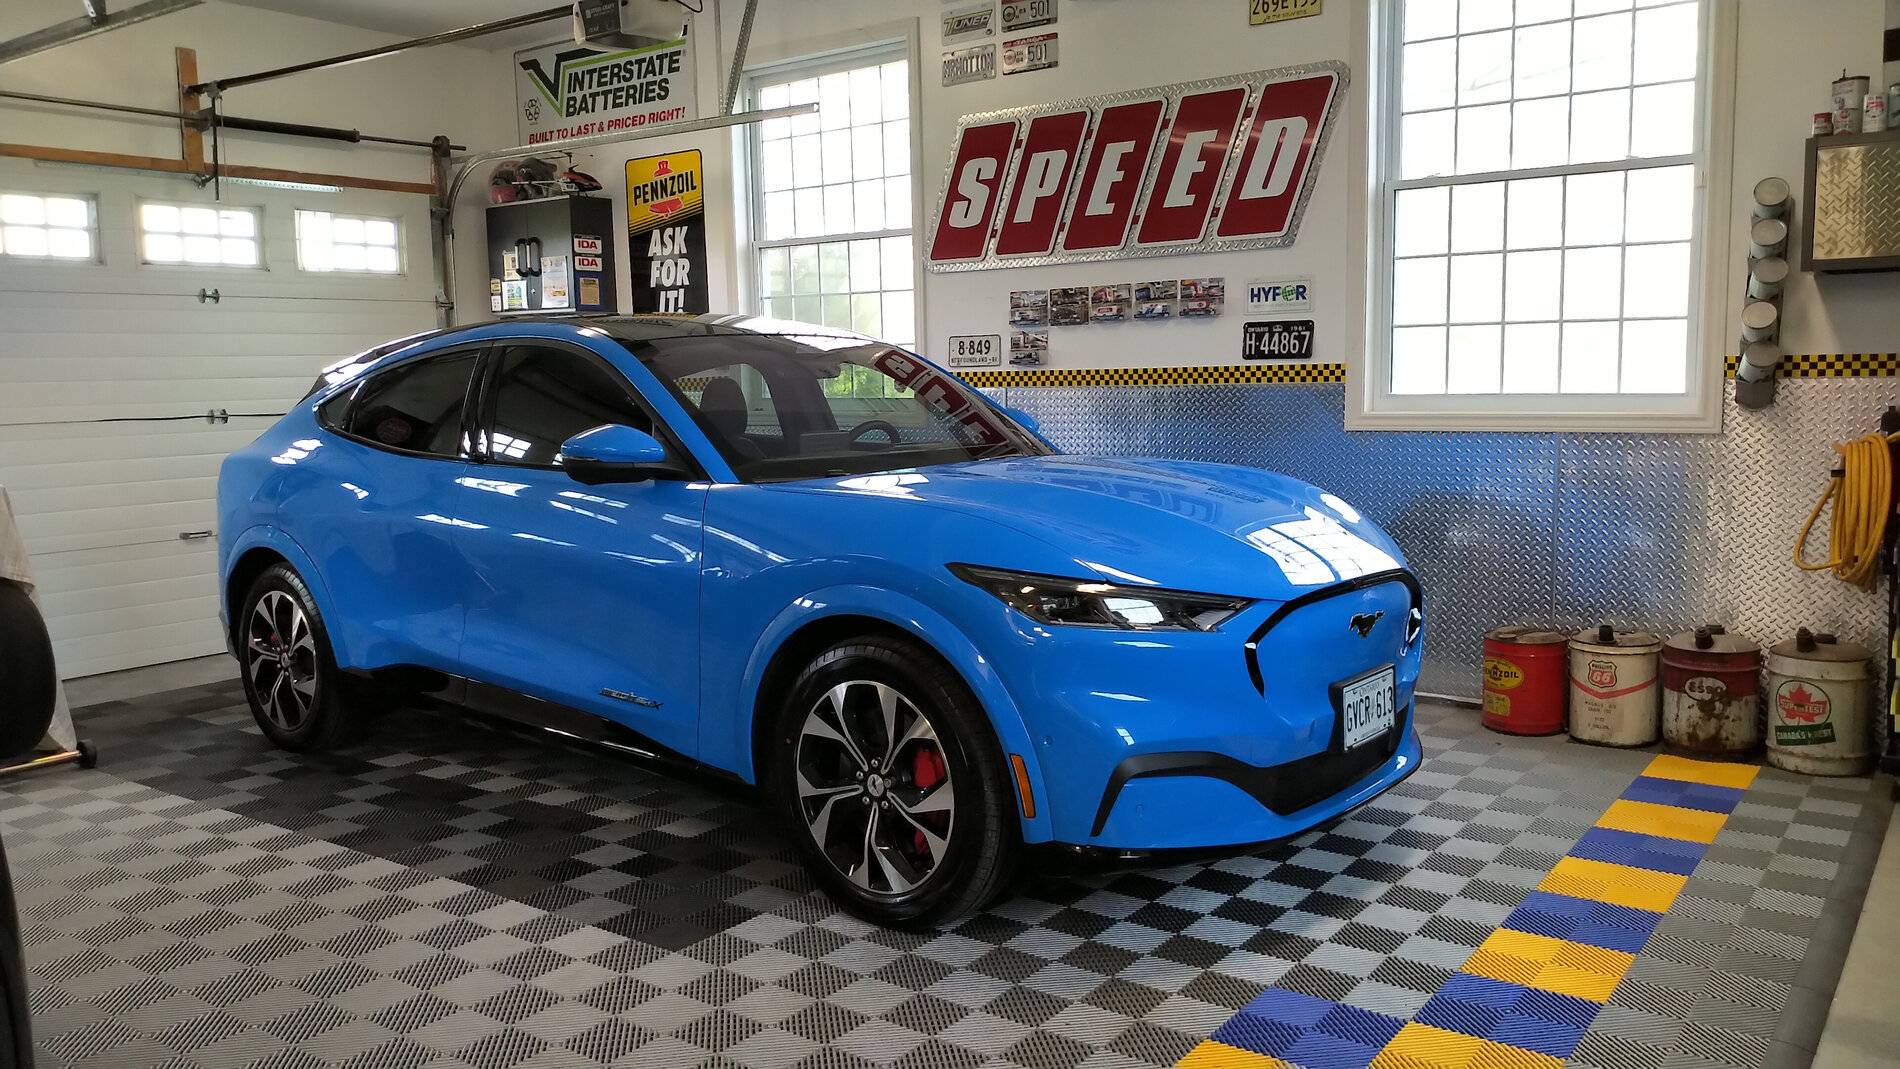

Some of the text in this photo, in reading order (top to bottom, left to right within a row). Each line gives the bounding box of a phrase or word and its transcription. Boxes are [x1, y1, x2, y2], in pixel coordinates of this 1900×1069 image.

[944, 9, 992, 36] TUNER
[1031, 0, 1049, 18] 501
[1028, 43, 1047, 61] 501
[567, 50, 682, 93] INTERSTATE
[565, 78, 670, 117] BATTERIES
[529, 107, 685, 144] BUILT TO LAST & PRICED RIGHT!
[948, 115, 1309, 228] SPEED
[633, 170, 697, 206] PENNZOIL
[578, 240, 598, 249] IDA
[648, 226, 688, 257] ASK
[578, 258, 598, 267] IDA
[650, 258, 690, 288] FOR
[659, 288, 685, 312] IT!
[1251, 285, 1307, 302] HYFOR
[1376, 686, 1393, 718] 613
